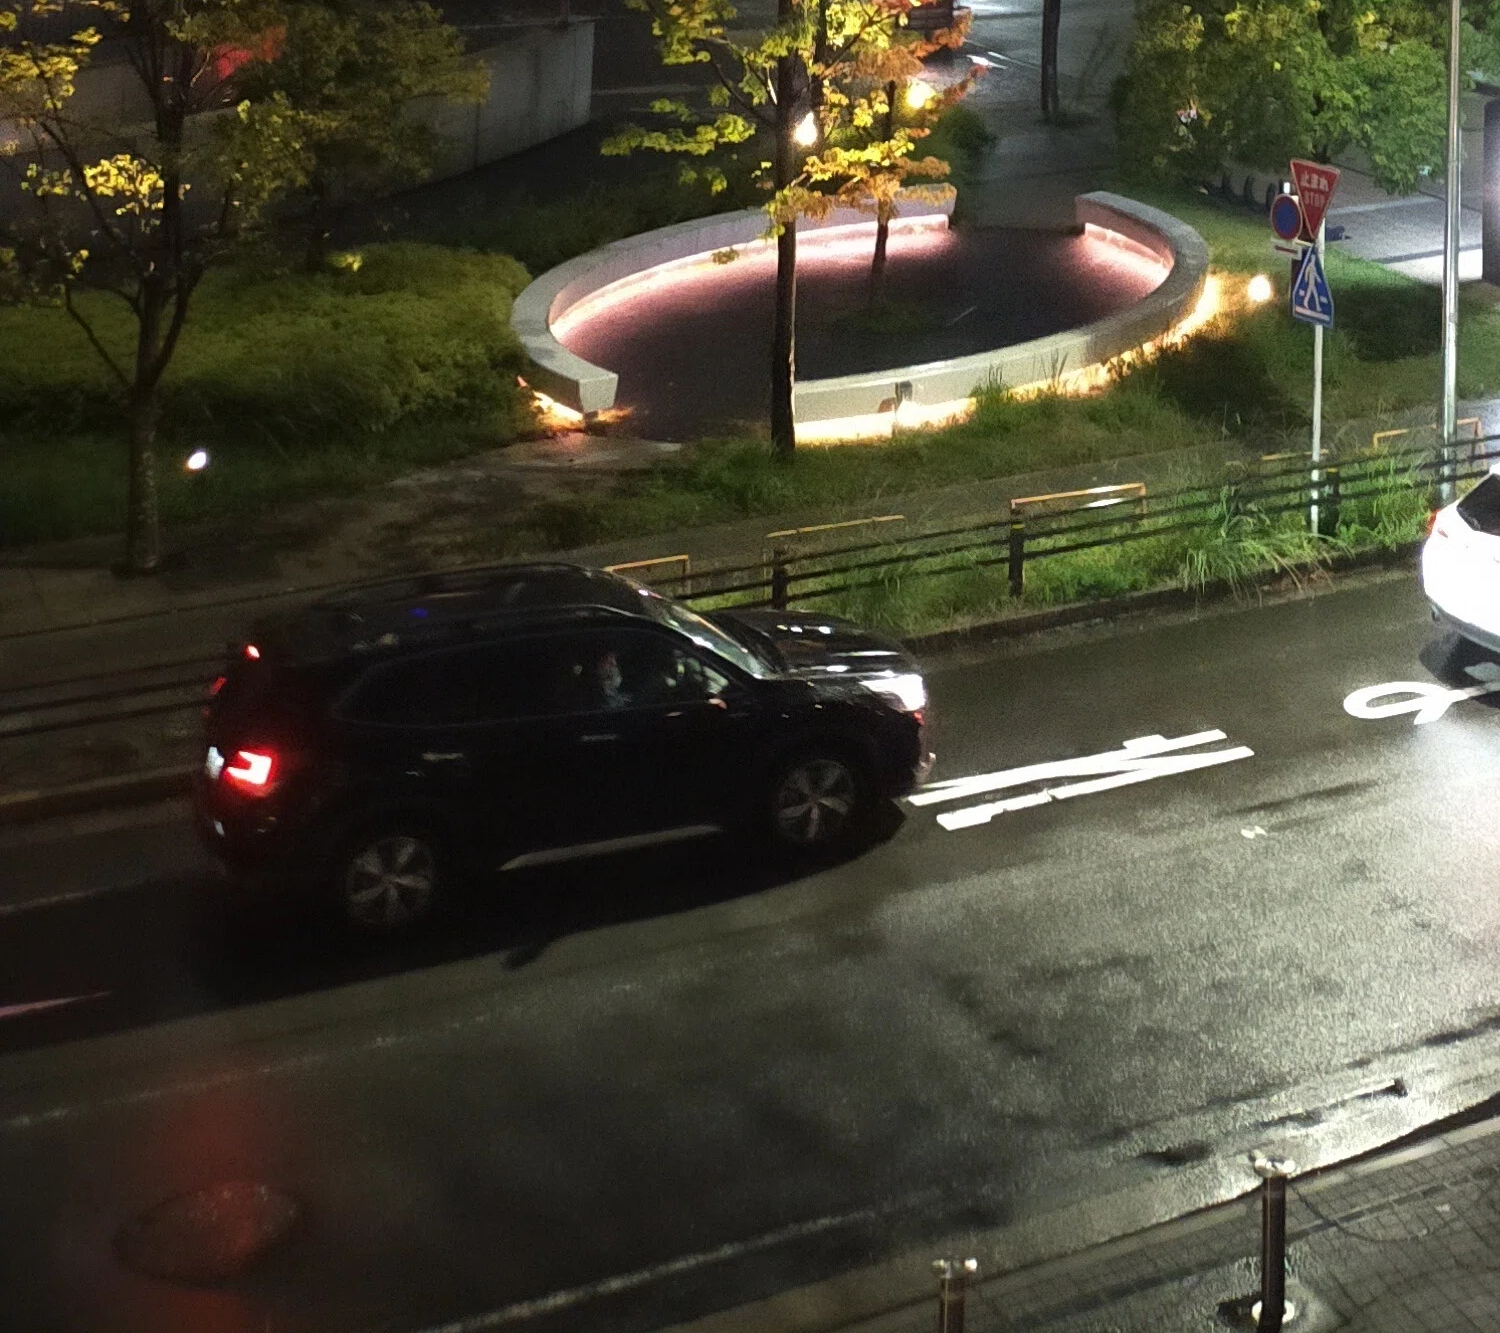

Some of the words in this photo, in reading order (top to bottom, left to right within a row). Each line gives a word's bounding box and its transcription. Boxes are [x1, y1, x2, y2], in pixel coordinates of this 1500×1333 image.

[1300, 171, 1329, 192] 止まれ
[1303, 190, 1326, 206] STOP
